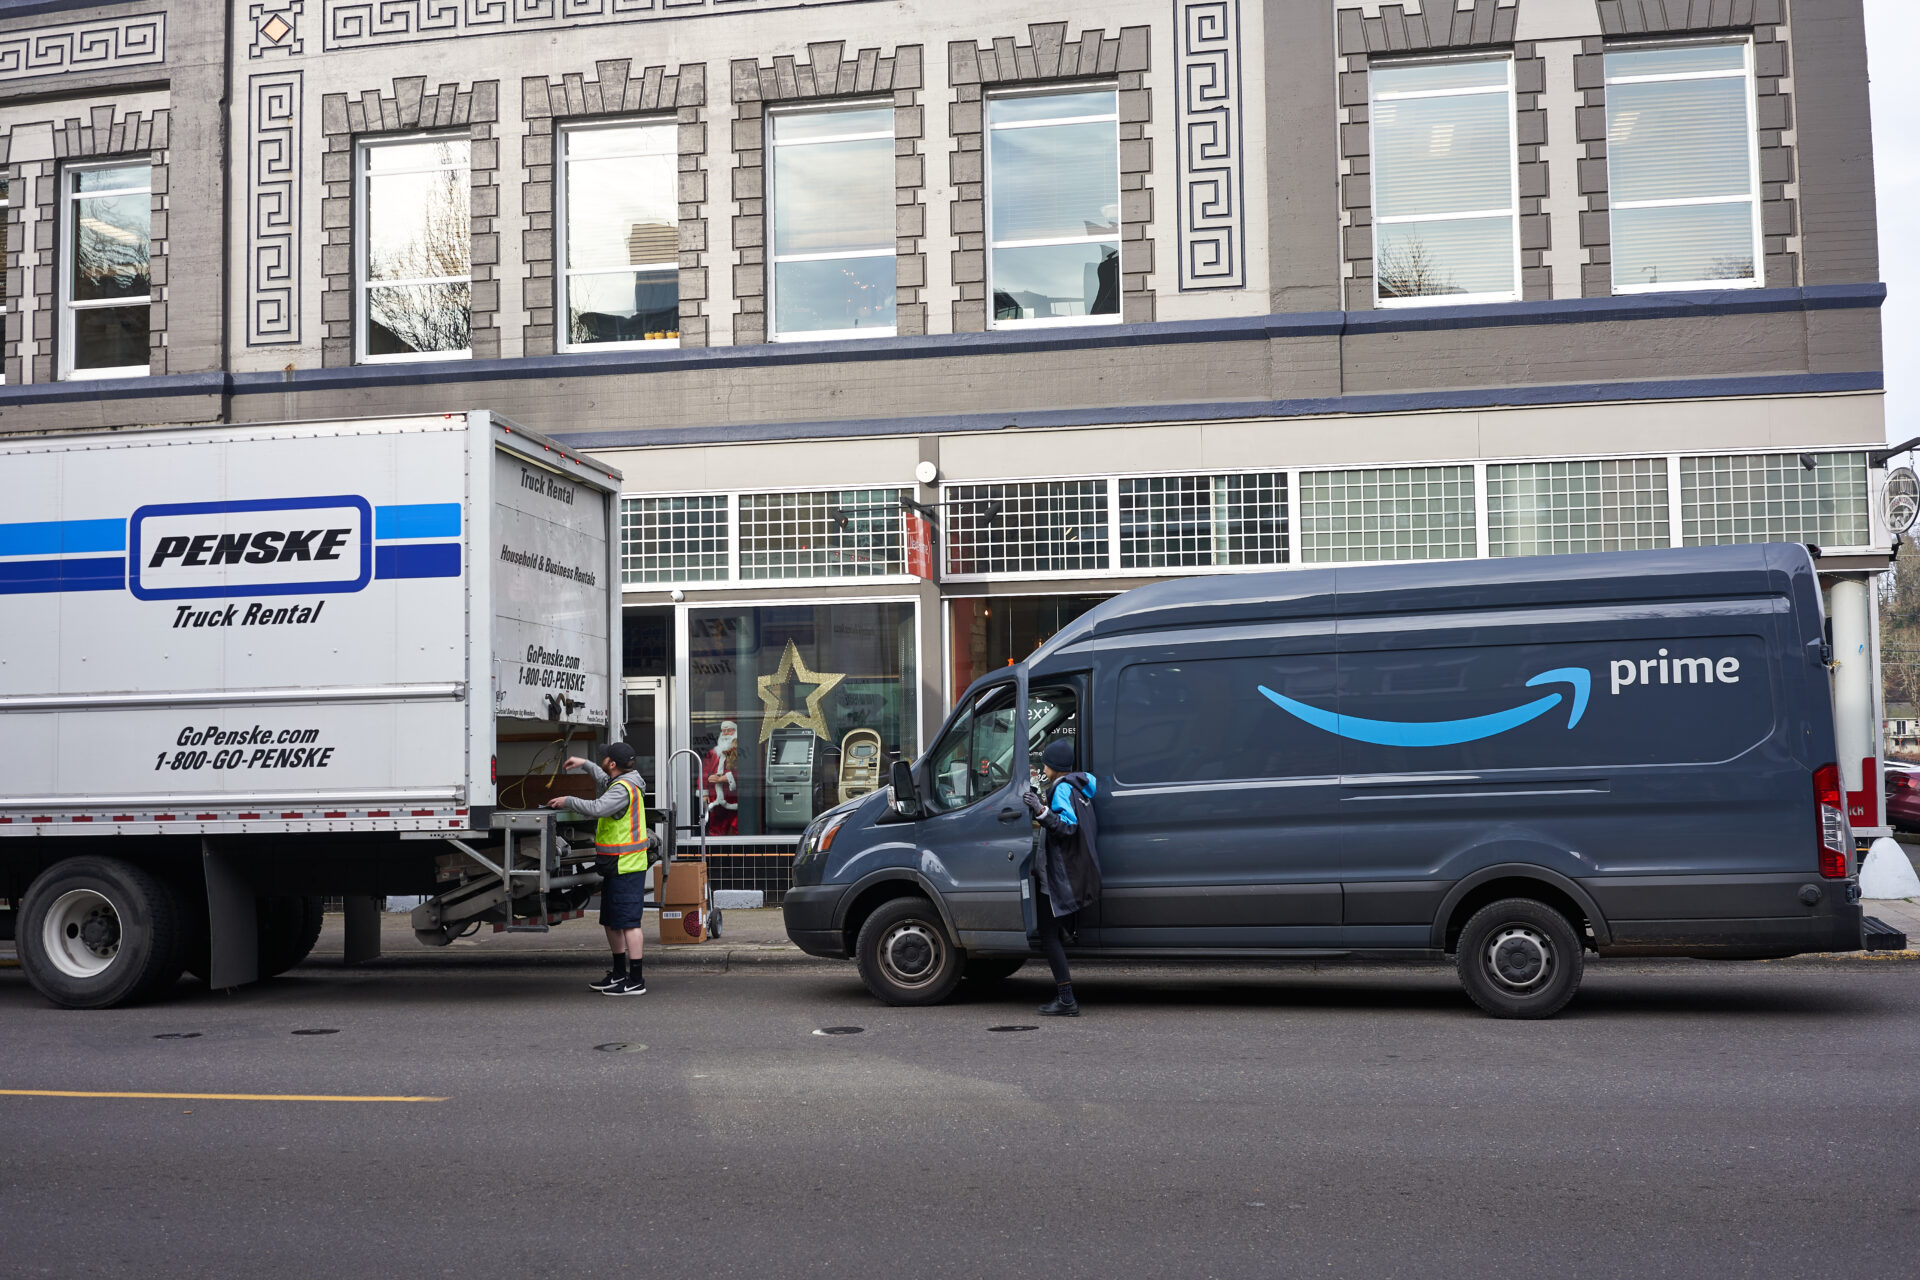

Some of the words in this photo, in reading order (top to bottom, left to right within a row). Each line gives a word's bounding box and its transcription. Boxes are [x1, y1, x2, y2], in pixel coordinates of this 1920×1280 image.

[521, 467, 545, 494] Truck
[547, 479, 575, 505] Rental
[148, 528, 352, 568] PENSKE
[501, 544, 538, 569] Household
[538, 556, 544, 571] &
[545, 558, 574, 580] Business
[574, 566, 596, 586] Rentals
[172, 604, 239, 628] Truck
[241, 600, 326, 626] Rental
[526, 644, 580, 670] GoPenske.com
[518, 666, 586, 692] 1-800-GO-PENSKE
[1610, 648, 1740, 694] prime
[176, 725, 320, 746] GoPenske.com
[154, 747, 335, 771] 1-800-GO-PENSKE
[1849, 804, 1864, 816] ICH
